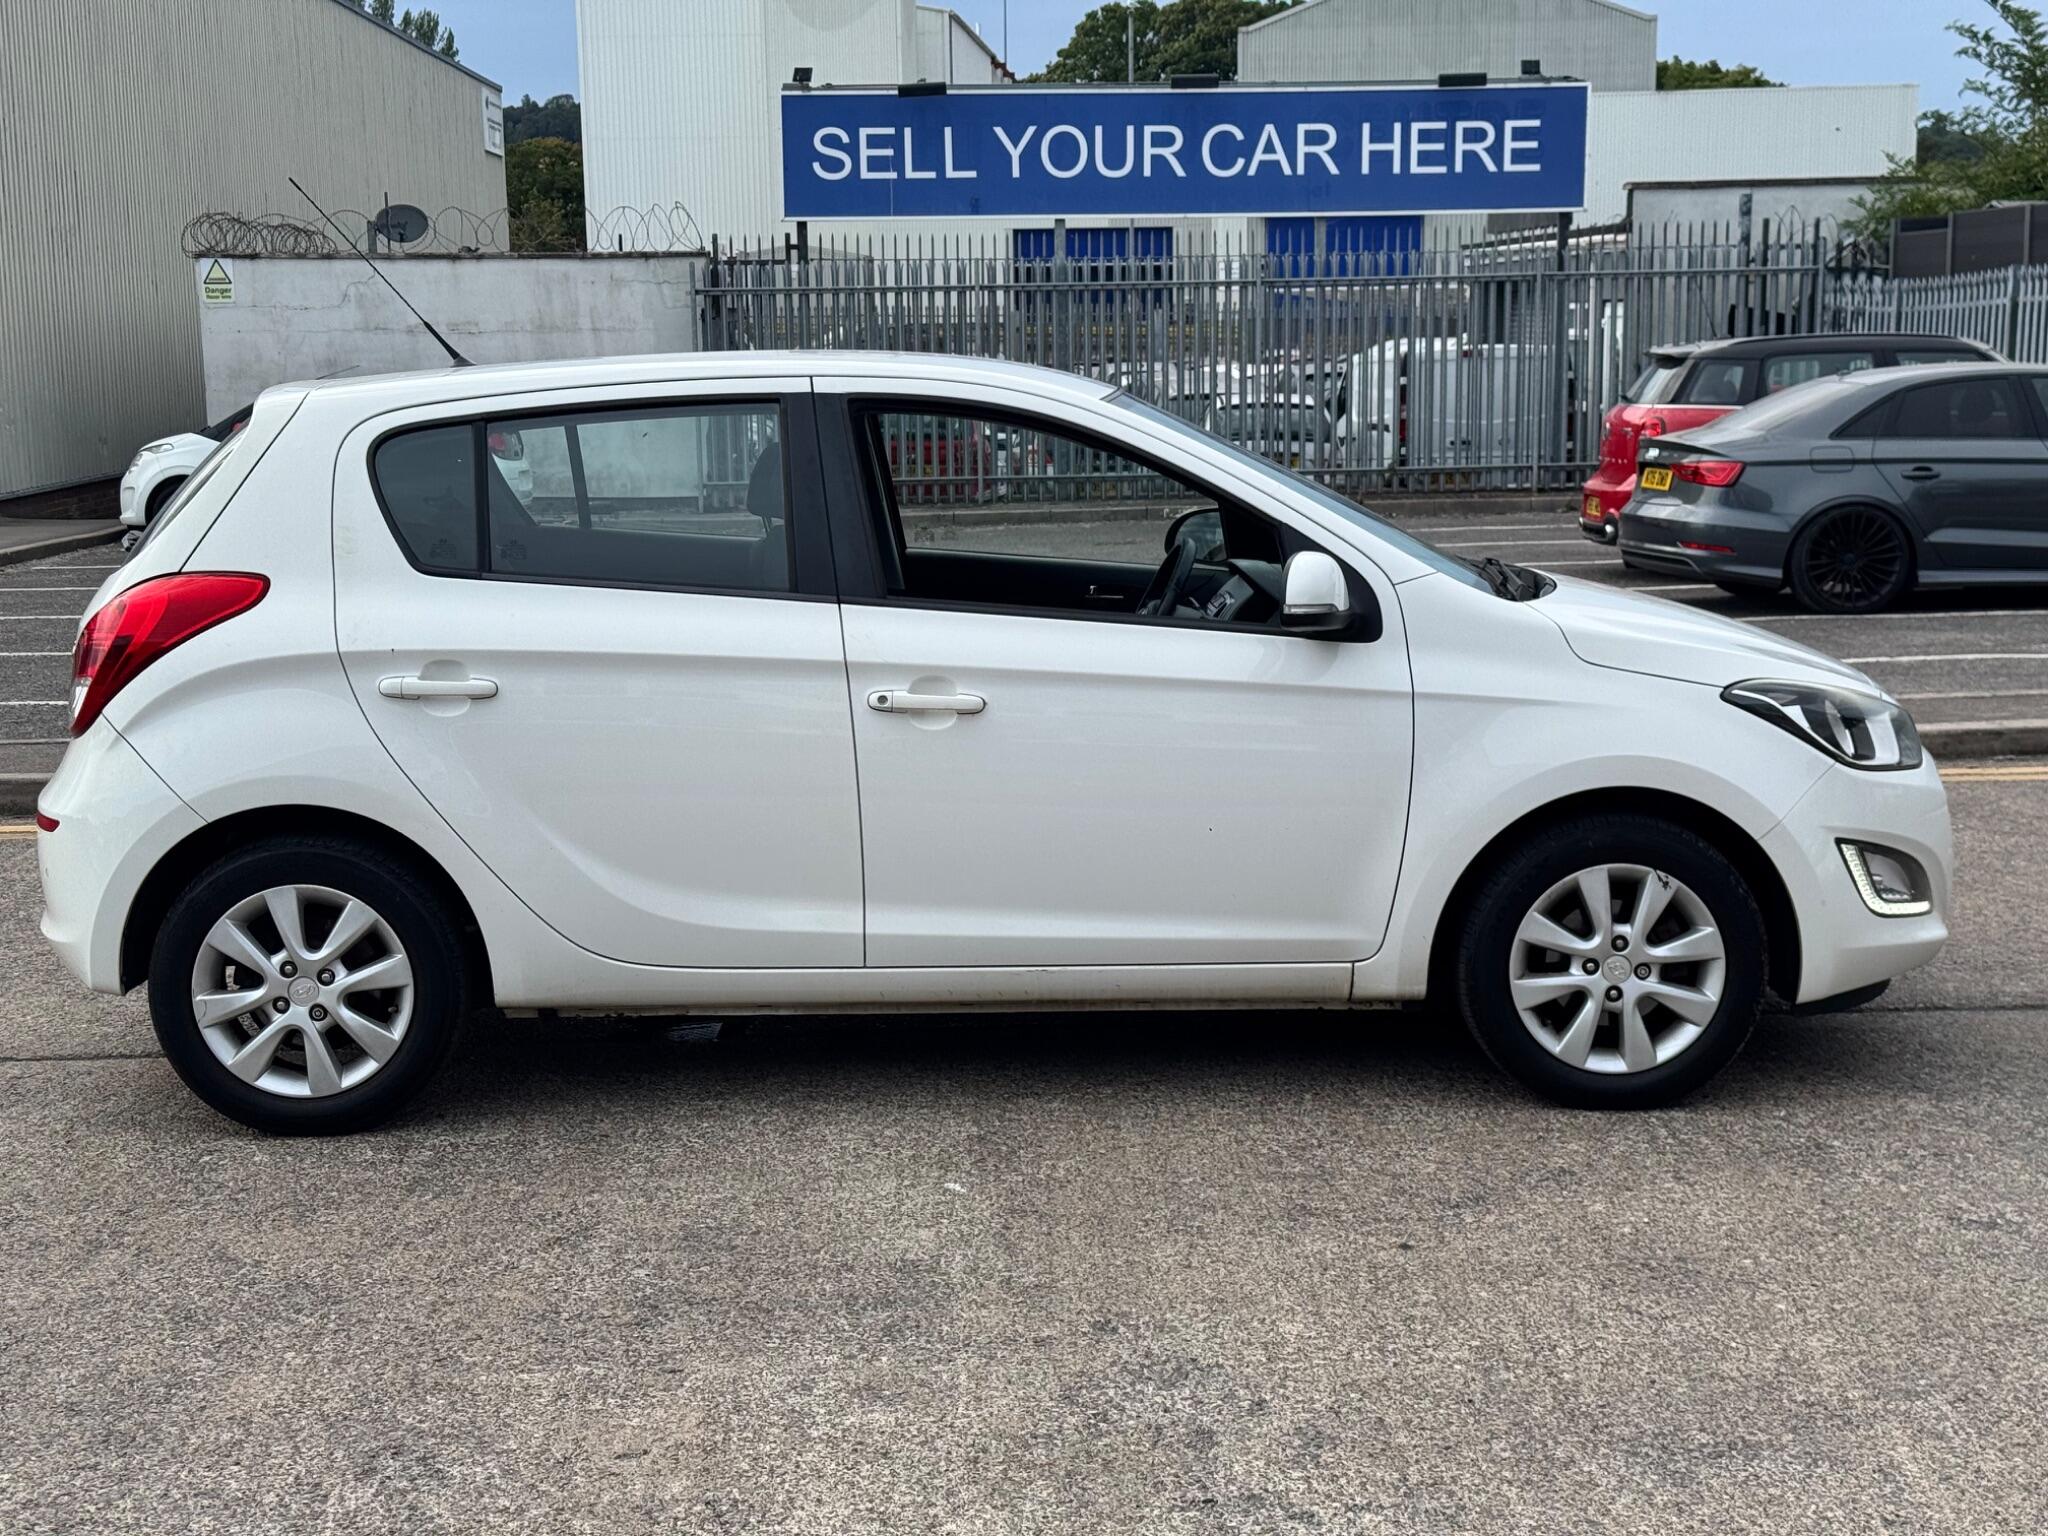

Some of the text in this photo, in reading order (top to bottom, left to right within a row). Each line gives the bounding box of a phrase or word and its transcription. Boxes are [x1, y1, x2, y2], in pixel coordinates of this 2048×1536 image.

[812, 119, 1541, 180] SELL YOUR CAR HERE
[204, 286, 232, 295] Danger
